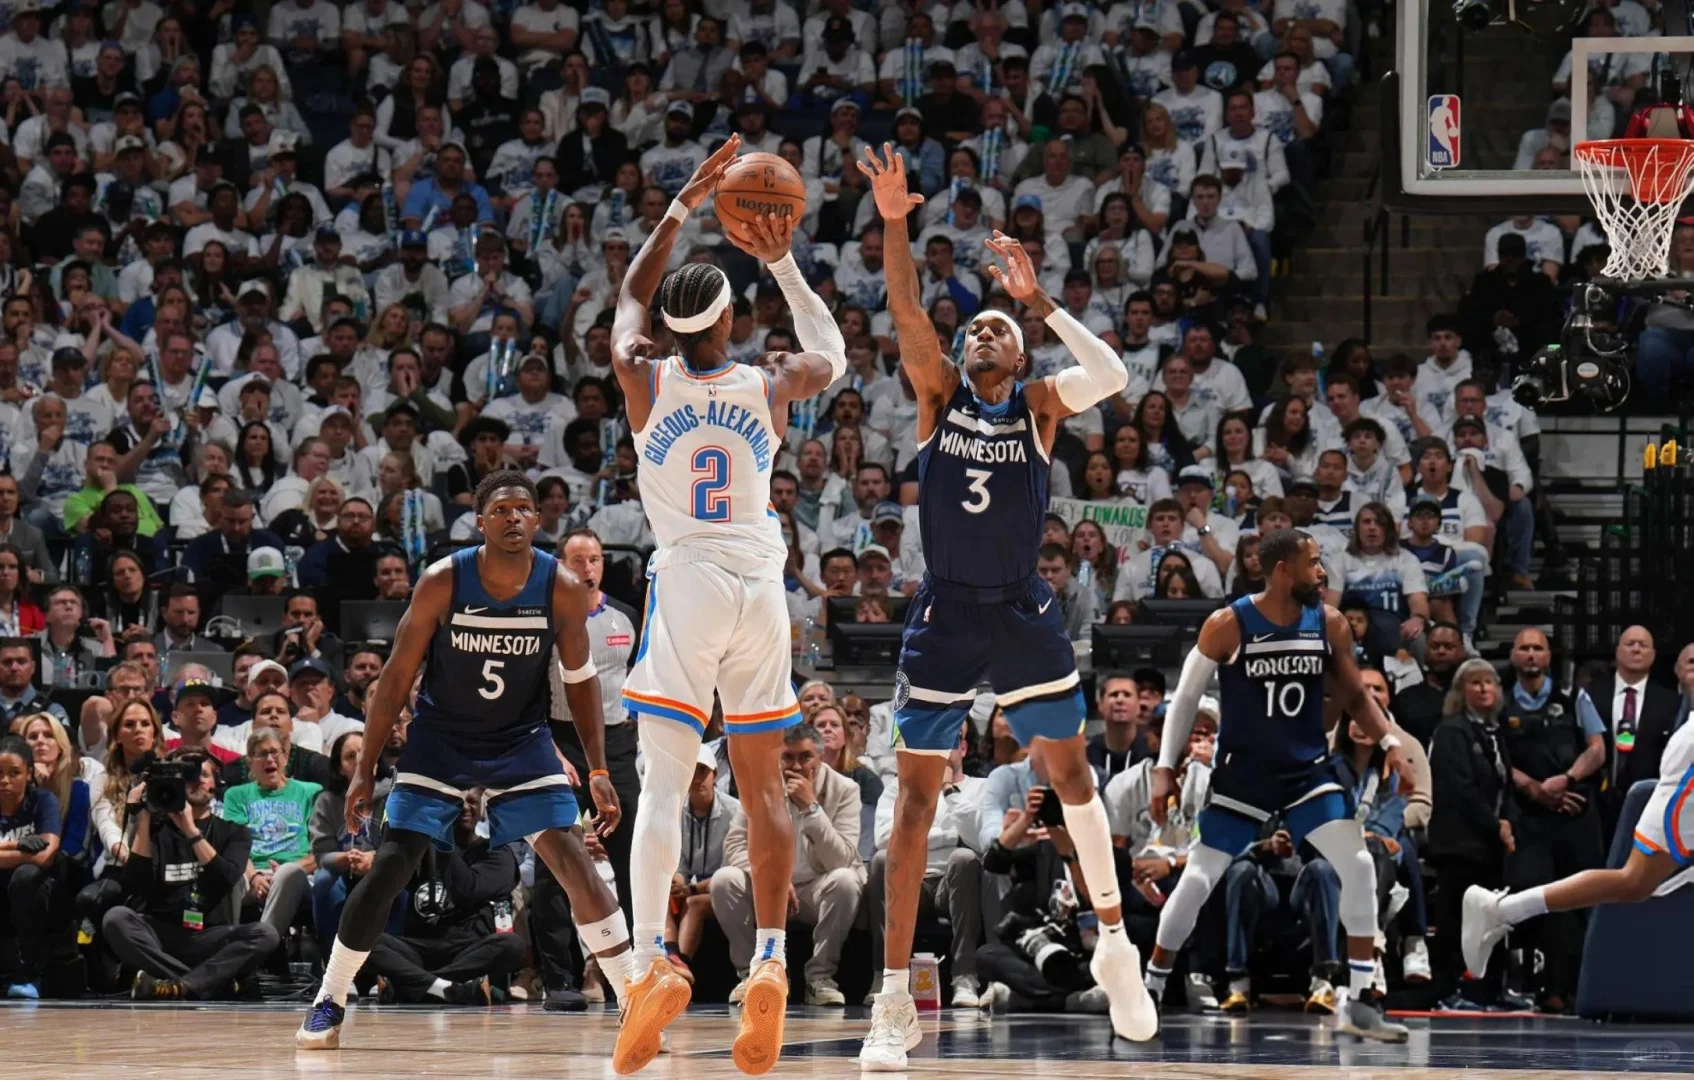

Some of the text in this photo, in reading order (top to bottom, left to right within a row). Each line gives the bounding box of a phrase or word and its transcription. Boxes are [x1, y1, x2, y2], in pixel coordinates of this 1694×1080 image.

[1432, 151, 1449, 163] NBA
[644, 400, 770, 473] GILGEOUS-ALEXANDER
[938, 429, 1027, 464] MINNESOTA
[691, 445, 731, 523] 2
[961, 468, 993, 513] 3
[1083, 504, 1146, 528] EDWARDS
[1380, 590, 1399, 611] 11
[451, 630, 540, 655] MINNESOTA
[478, 659, 505, 700] 5
[1264, 681, 1305, 717] 10
[601, 928, 611, 937] 5
